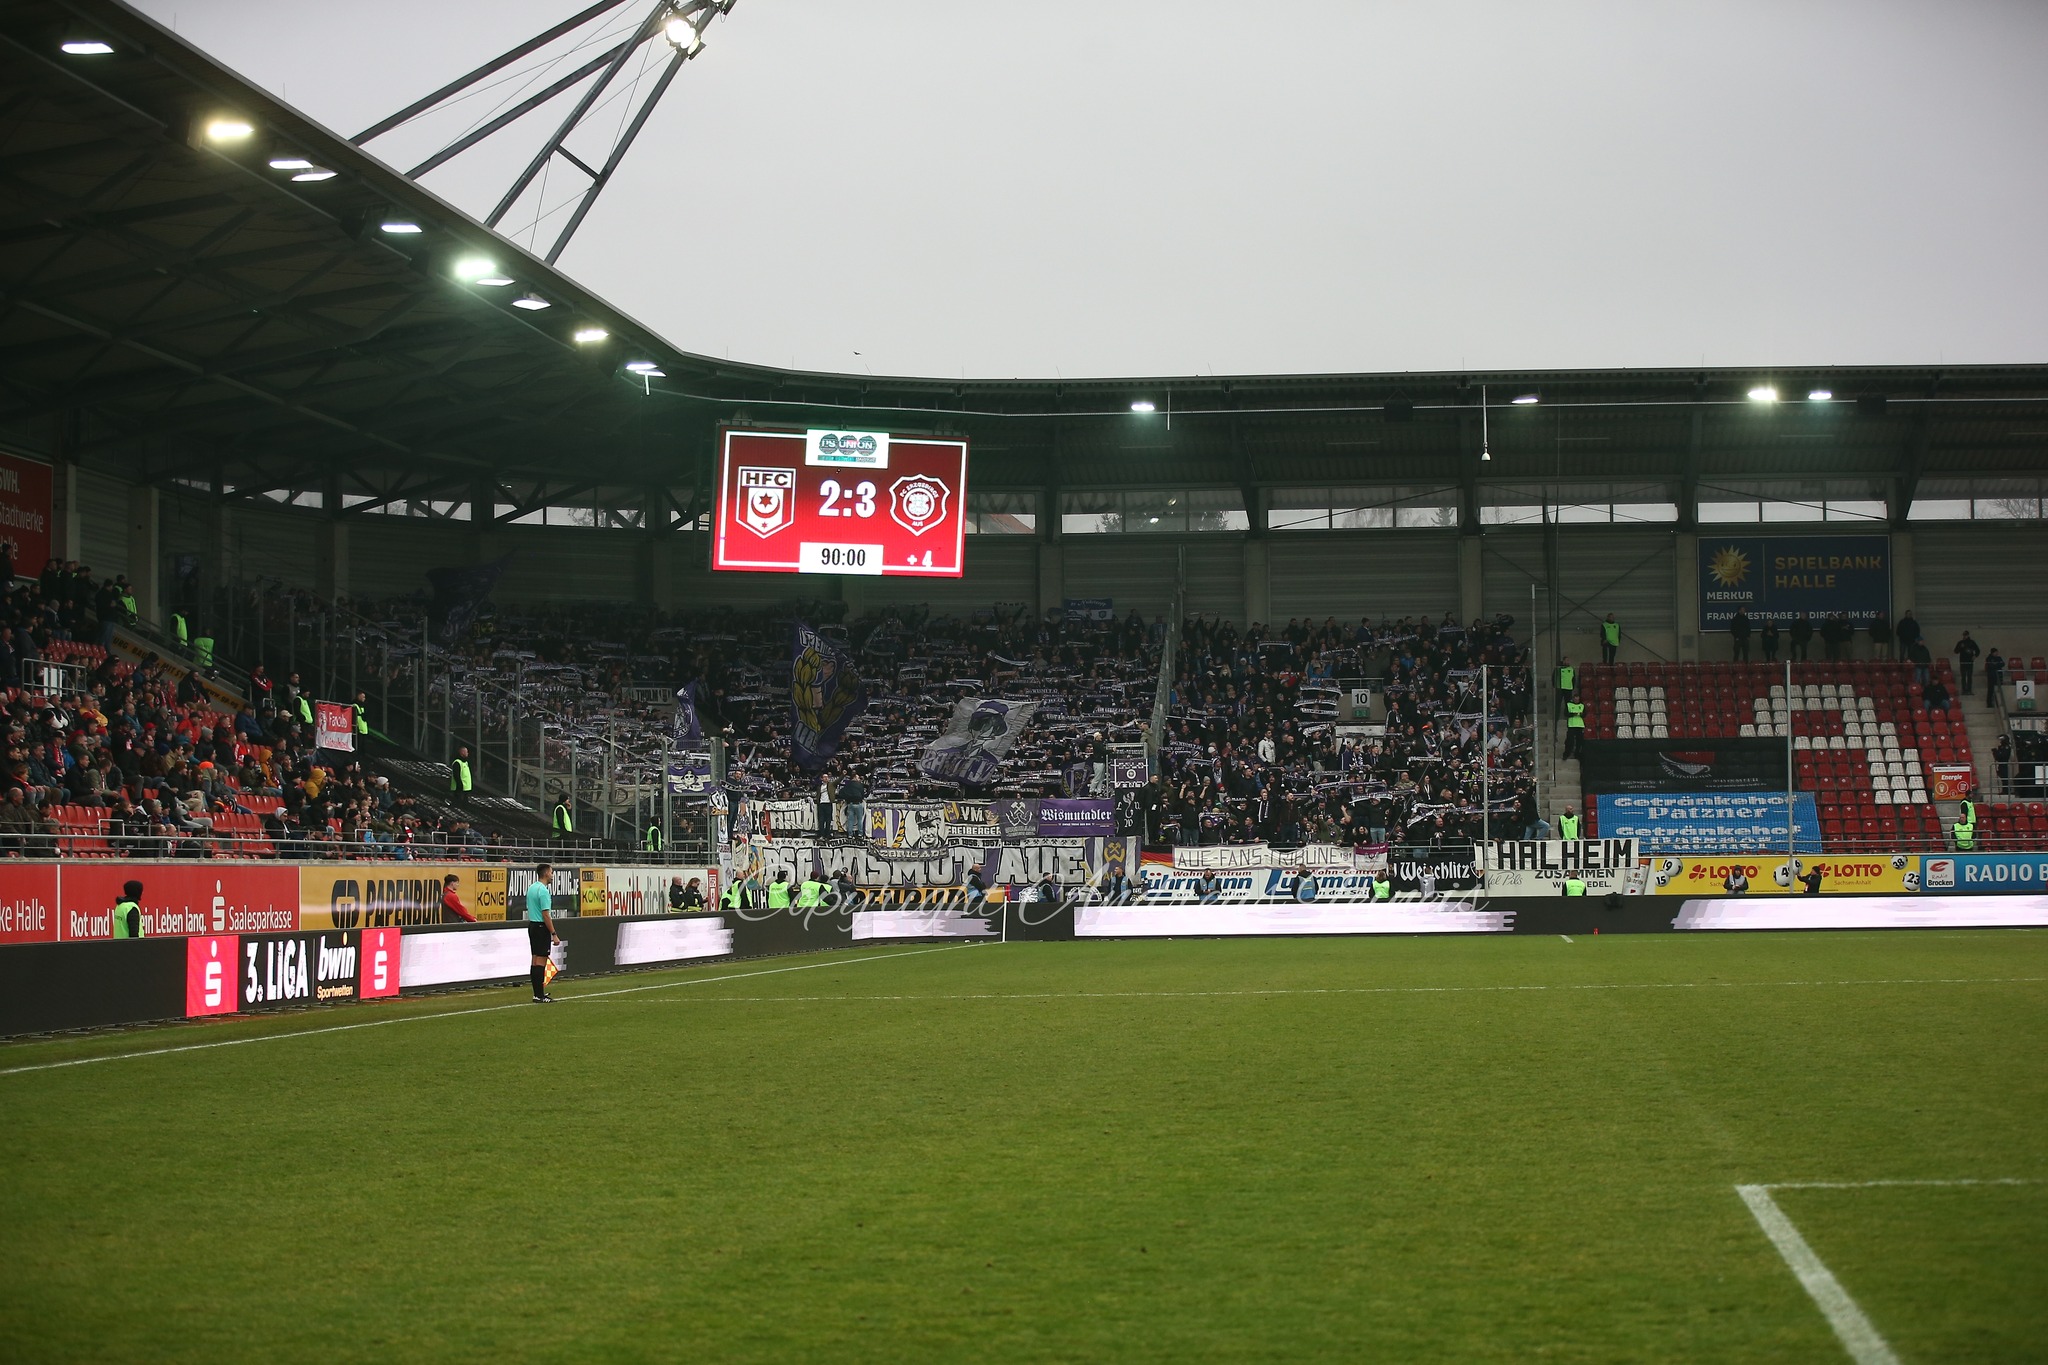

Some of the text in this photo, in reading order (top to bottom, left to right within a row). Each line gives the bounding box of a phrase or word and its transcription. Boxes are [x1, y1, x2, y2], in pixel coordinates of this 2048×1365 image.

[838, 440, 873, 450] UNION
[745, 472, 789, 487] HFC
[818, 479, 877, 518] 2:3
[0, 502, 44, 533] tadtwerke
[821, 548, 866, 567] 90:00
[1774, 556, 1882, 570] SPIELBANK
[1775, 574, 1836, 588] HALLE
[1706, 591, 1754, 600] MERKUR
[1706, 612, 1793, 621] FRANESTRAßE
[1862, 610, 1878, 619] K&
[2021, 684, 2030, 696] 9
[1355, 693, 1368, 704] 10
[1614, 794, 1798, 807] Getränkehof
[1041, 808, 1112, 820] Wismutadler
[1648, 807, 1768, 820] Patzner
[1476, 838, 1632, 870] THALHEIM
[763, 846, 1086, 887] BSG WISMUT AUE
[1834, 864, 1883, 877] LOTTO
[1893, 858, 1904, 869] 38
[1710, 865, 1758, 879] LOTTO
[1907, 872, 1920, 885] 23
[1965, 863, 2033, 881] RADIO
[1656, 875, 1666, 885] 15
[477, 887, 504, 906] KÖNIG
[582, 886, 605, 903] KÖNIG
[365, 879, 442, 928] PAPENBUR
[16, 898, 46, 932] Halle
[70, 911, 89, 938] Rot
[91, 908, 110, 937] und
[155, 907, 183, 934] Leben
[185, 905, 207, 936] lang.
[228, 904, 293, 934] Saalesparkasse
[317, 931, 356, 982] bwin
[245, 939, 309, 1004] 3. LIGA
[316, 985, 354, 1001] Sportwetten
